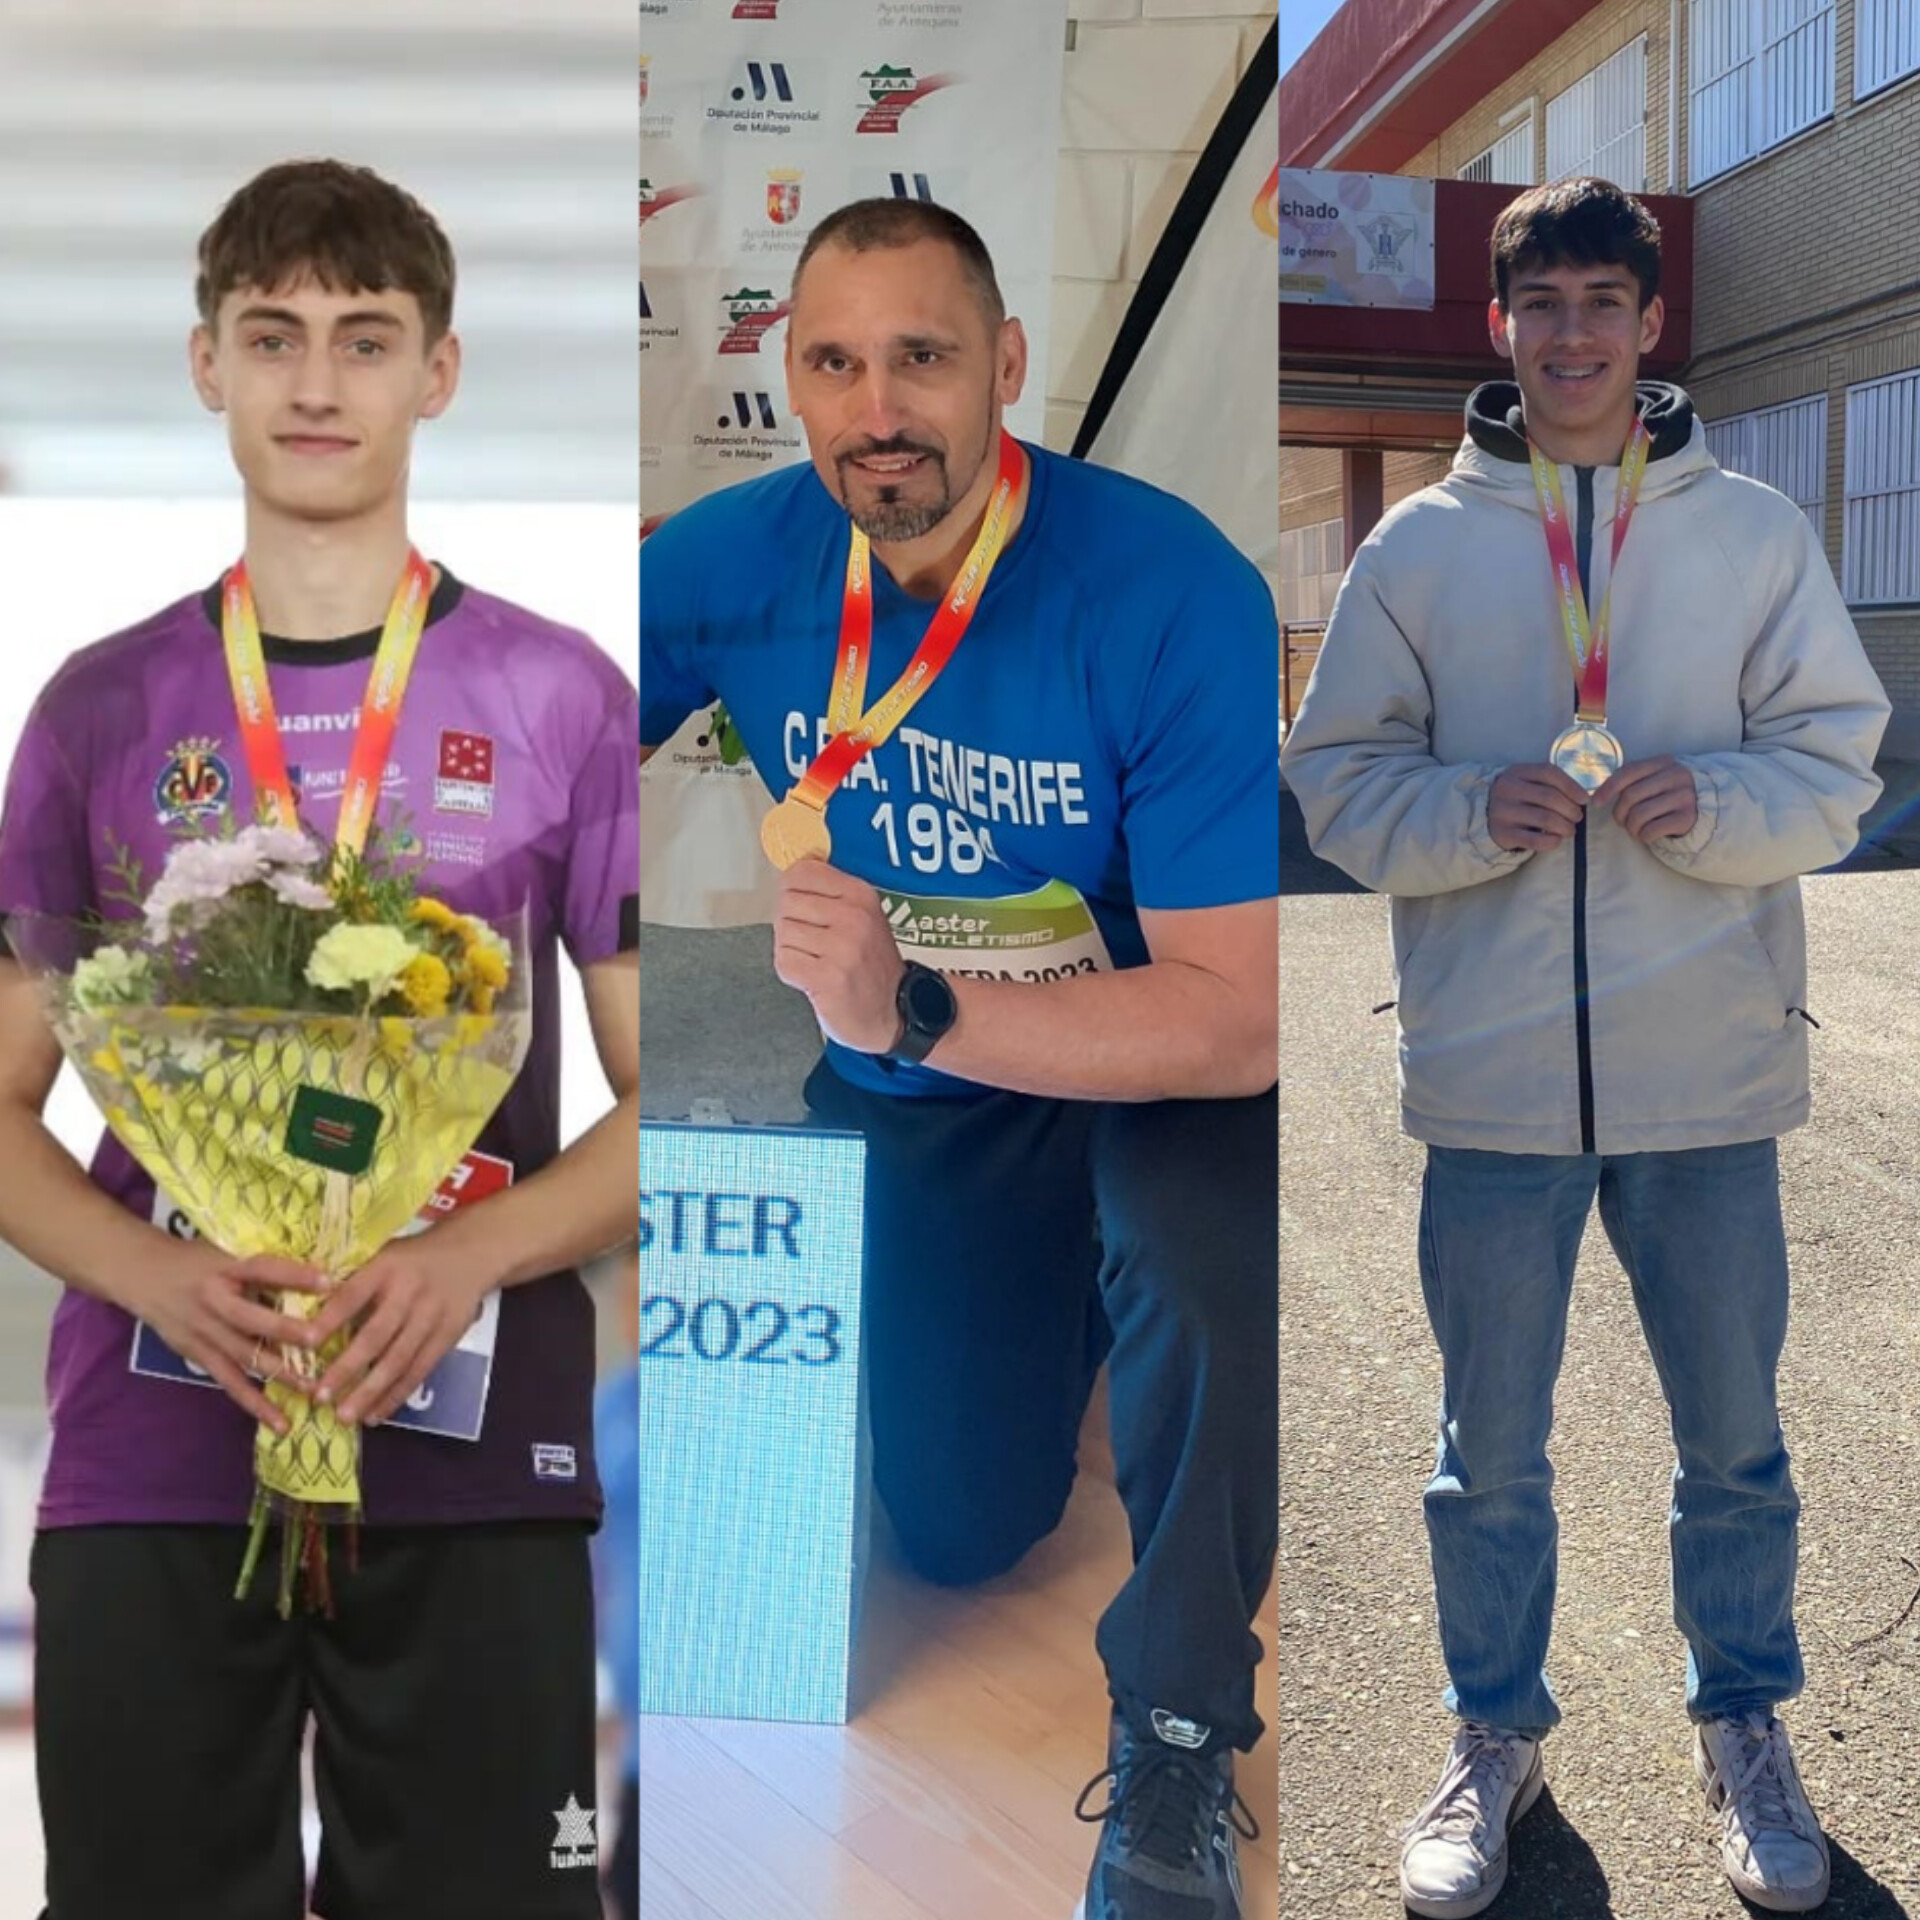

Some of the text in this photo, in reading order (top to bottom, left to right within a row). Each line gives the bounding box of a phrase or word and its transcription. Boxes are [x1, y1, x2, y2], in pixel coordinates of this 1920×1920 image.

[1279, 200, 1340, 219] chado
[1282, 245, 1296, 256] de
[276, 706, 361, 732] uanvi
[899, 726, 1089, 827] TENERIFE
[920, 927, 1055, 947] ATLETISMO
[640, 1295, 842, 1367] 2023
